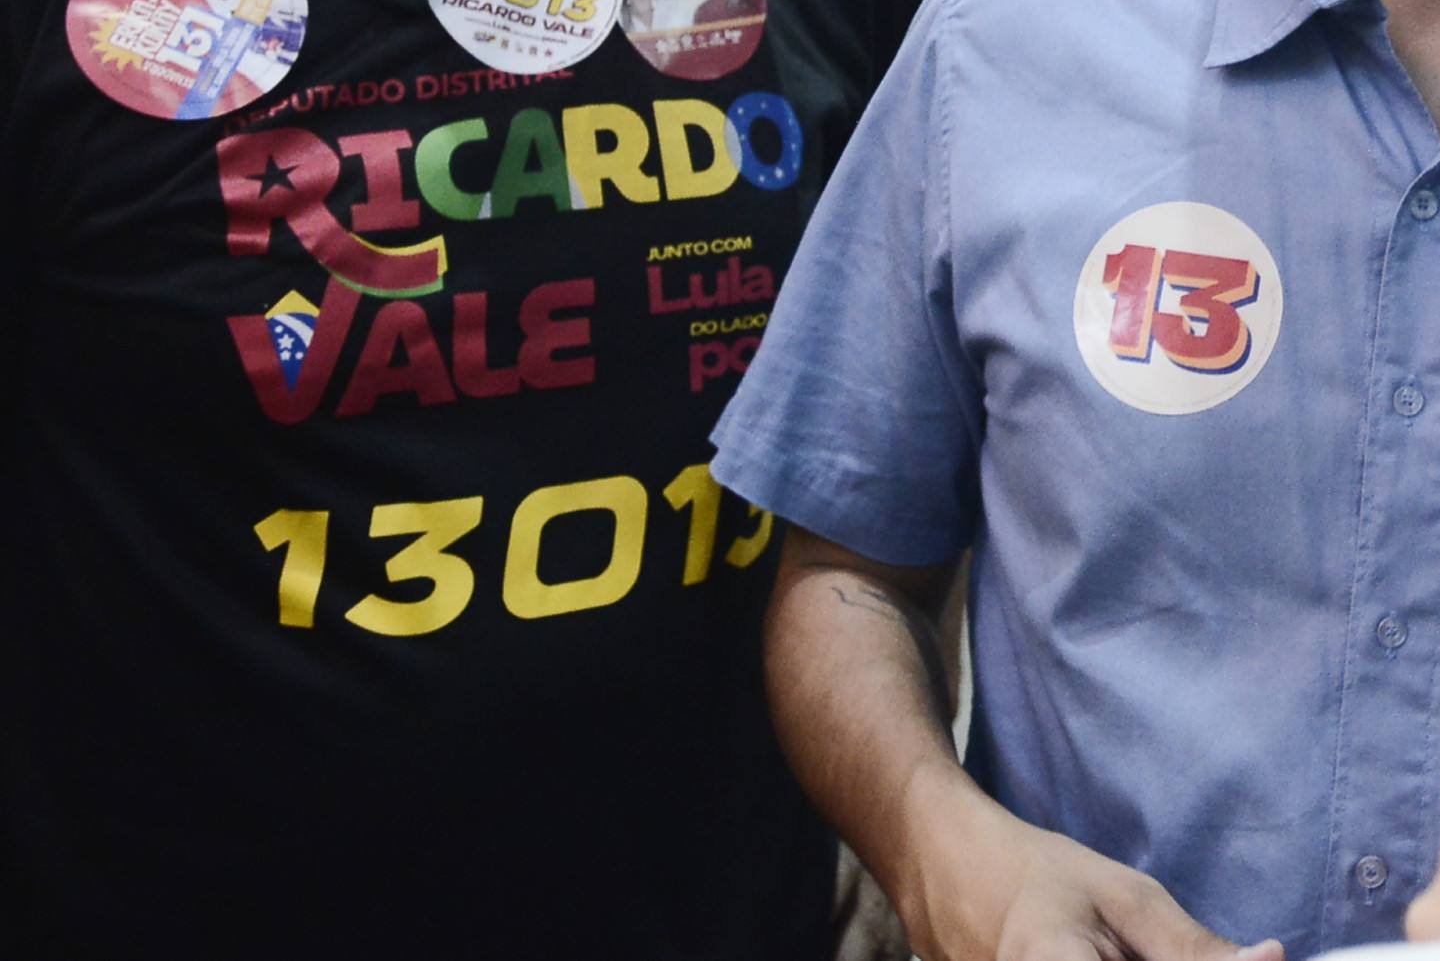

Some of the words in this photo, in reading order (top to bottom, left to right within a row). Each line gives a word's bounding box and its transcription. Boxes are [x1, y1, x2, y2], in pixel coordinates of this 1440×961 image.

[154, 6, 226, 72] 131
[543, 19, 595, 40] VALE
[215, 91, 806, 297] RICARDO
[647, 242, 708, 262] JUNTO
[710, 236, 752, 253] COM
[646, 256, 774, 315] Lula
[1101, 242, 1259, 375] 13
[226, 277, 597, 426] VALE
[690, 320, 717, 336] DO
[720, 313, 768, 333] LADO
